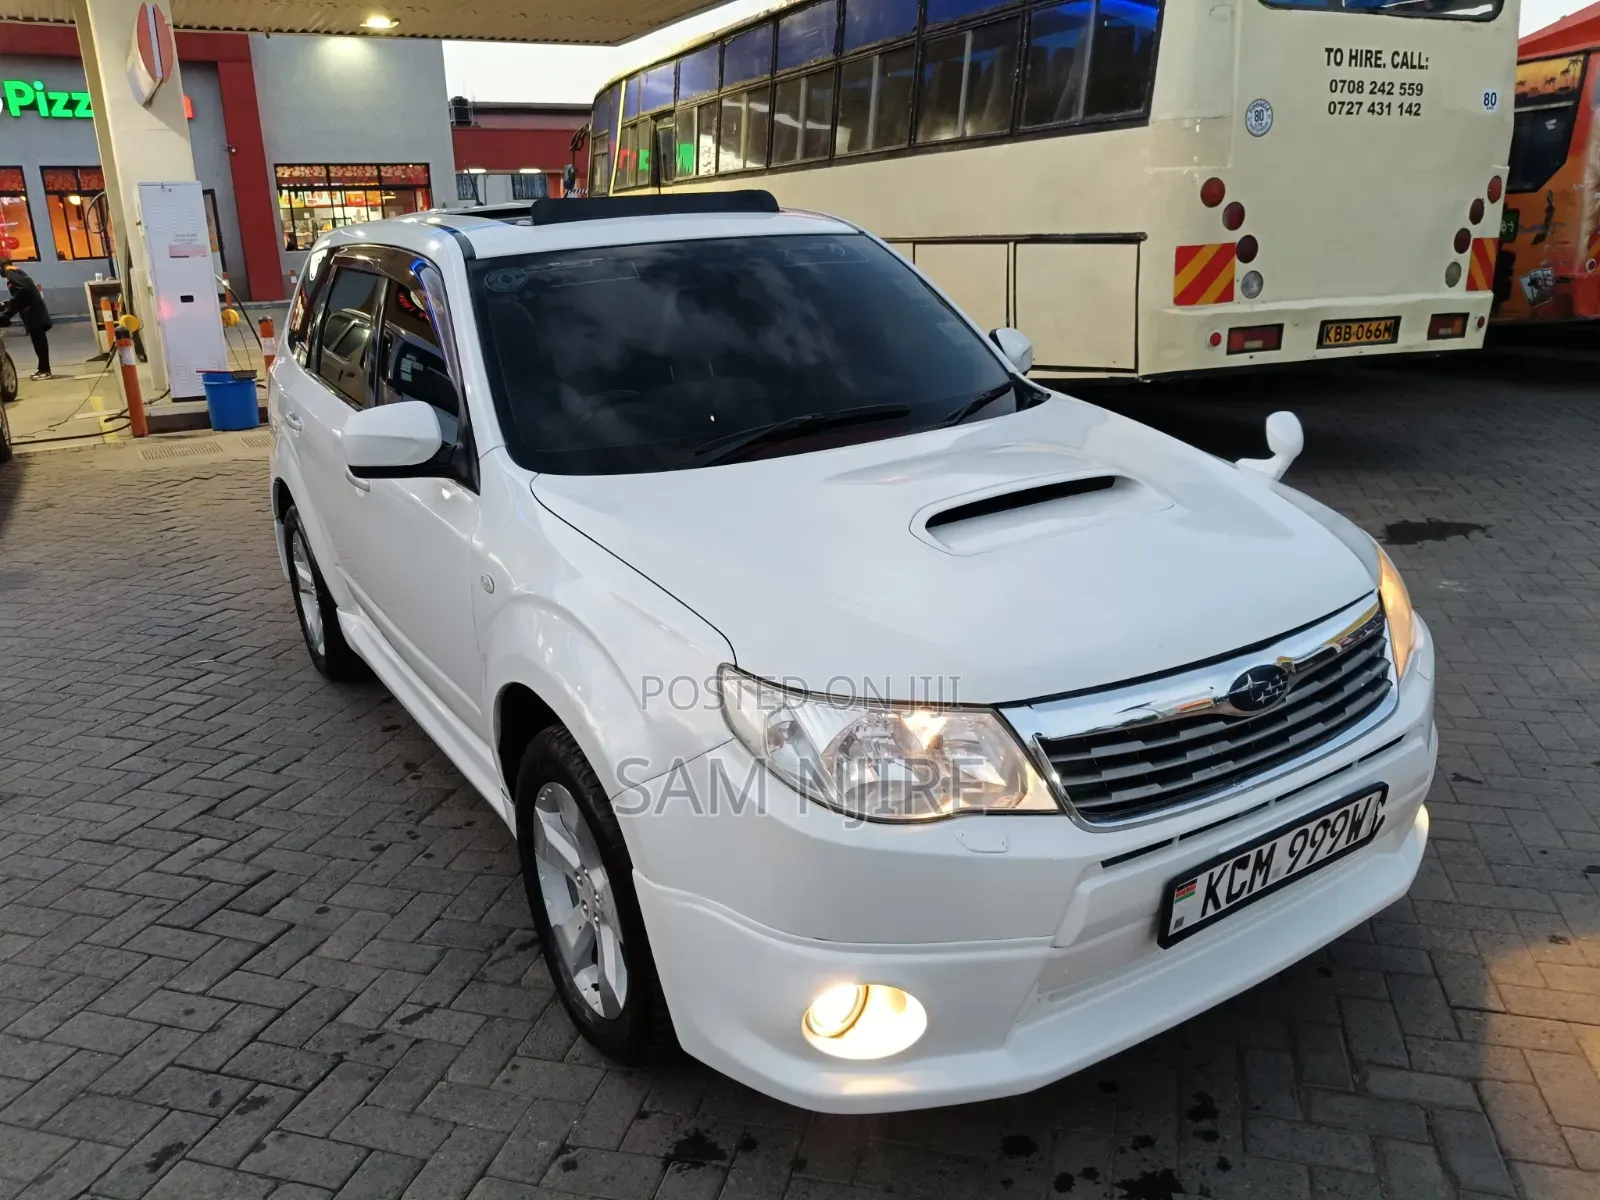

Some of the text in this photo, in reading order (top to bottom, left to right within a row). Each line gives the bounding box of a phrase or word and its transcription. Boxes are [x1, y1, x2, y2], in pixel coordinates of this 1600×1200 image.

[1325, 47, 1344, 67] TO
[1390, 50, 1429, 70] CALL:
[1329, 79, 1424, 97] 0708 242 559
[1483, 91, 1497, 107] 80
[1254, 109, 1265, 122] 80
[1328, 101, 1422, 117] 0727 431 142
[1201, 841, 1277, 918] KCM
